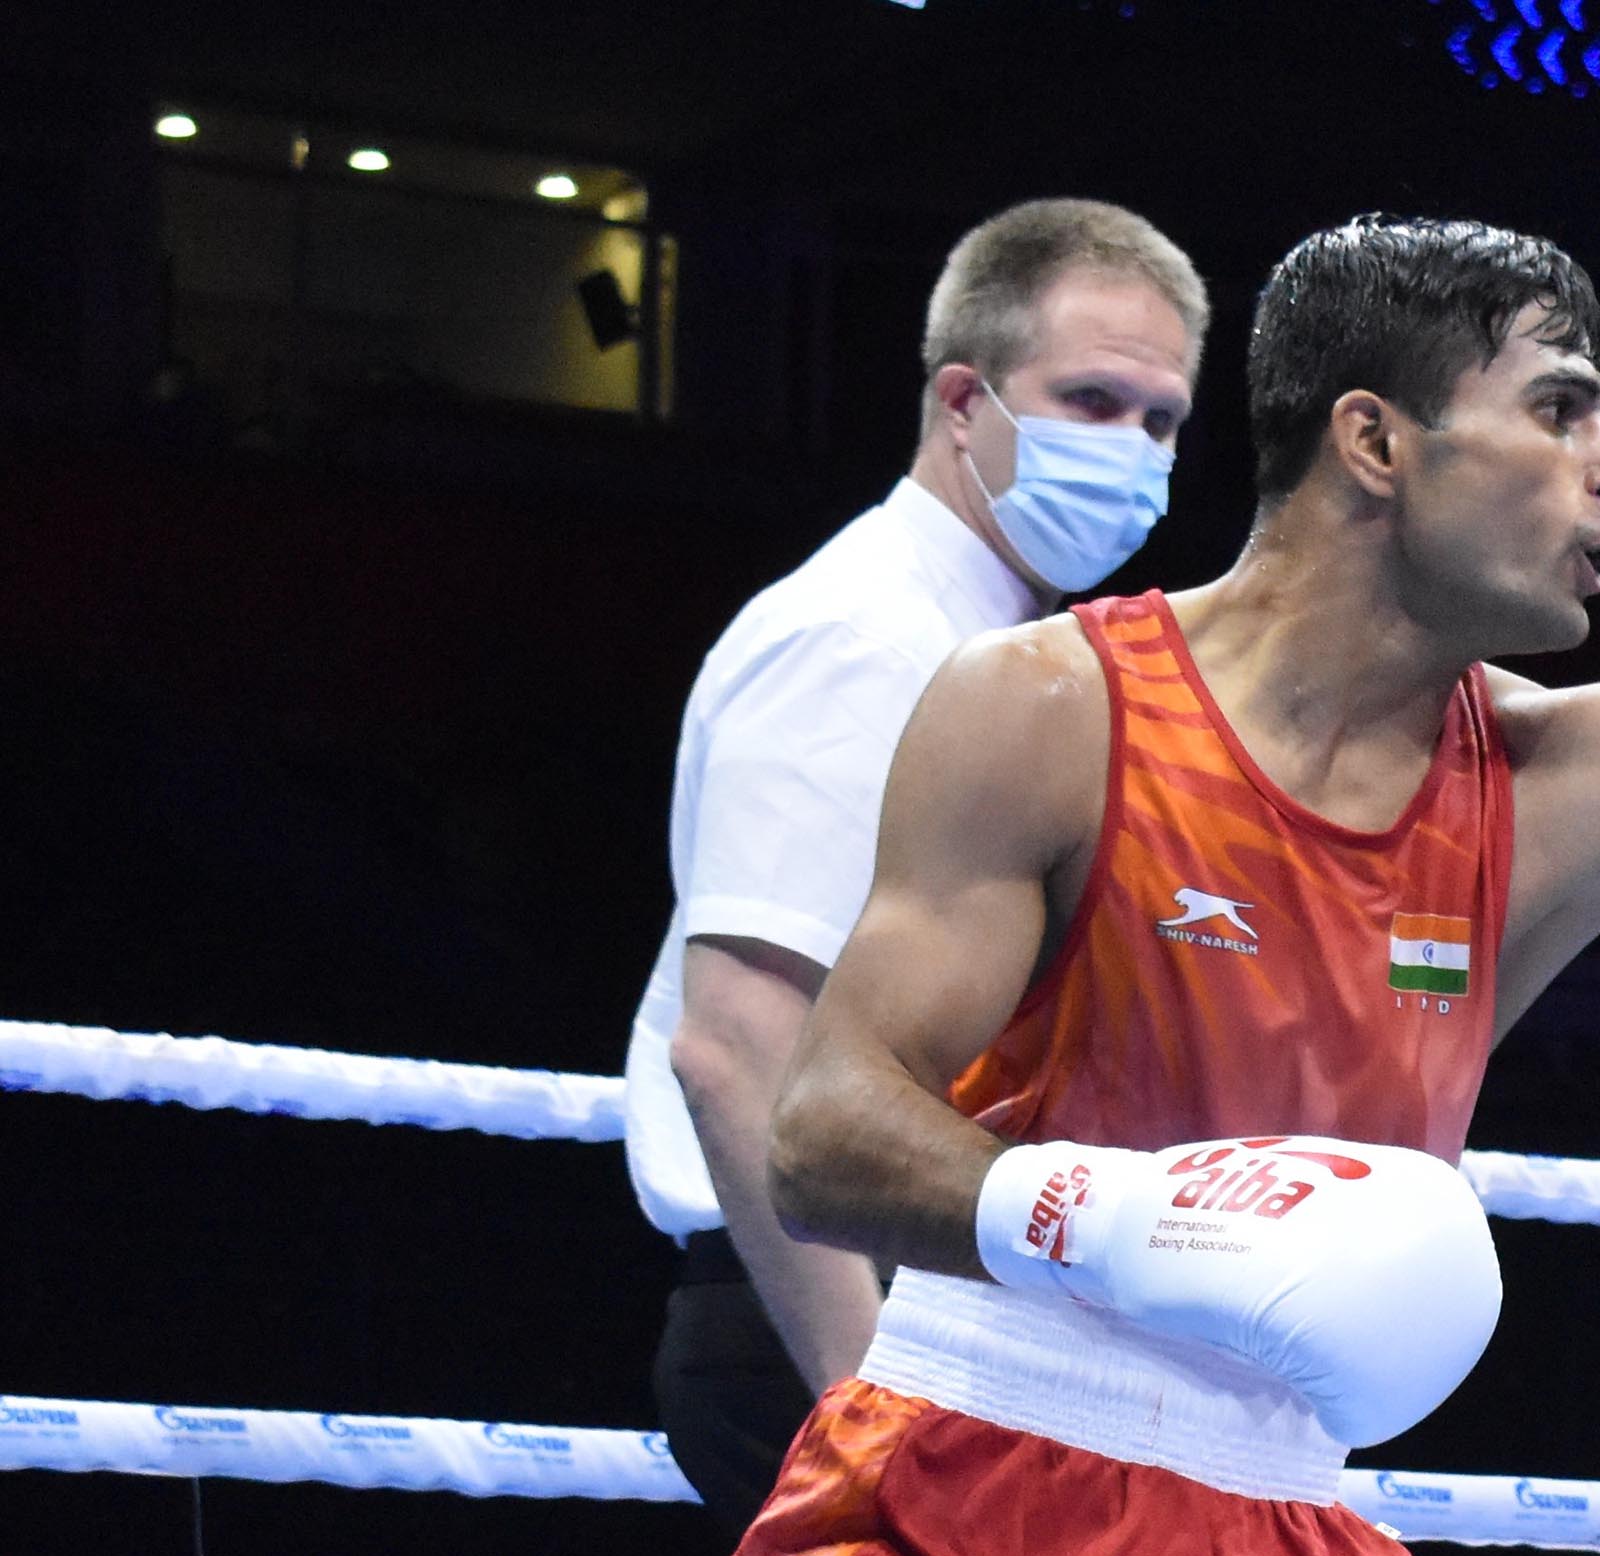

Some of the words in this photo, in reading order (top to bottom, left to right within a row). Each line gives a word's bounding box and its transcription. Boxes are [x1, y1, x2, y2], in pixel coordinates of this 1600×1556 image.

[1171, 1159, 1315, 1220] aiba
[1156, 1217, 1227, 1234] International
[1148, 1235, 1185, 1252] Boxing
[1186, 1237, 1252, 1255] Association
